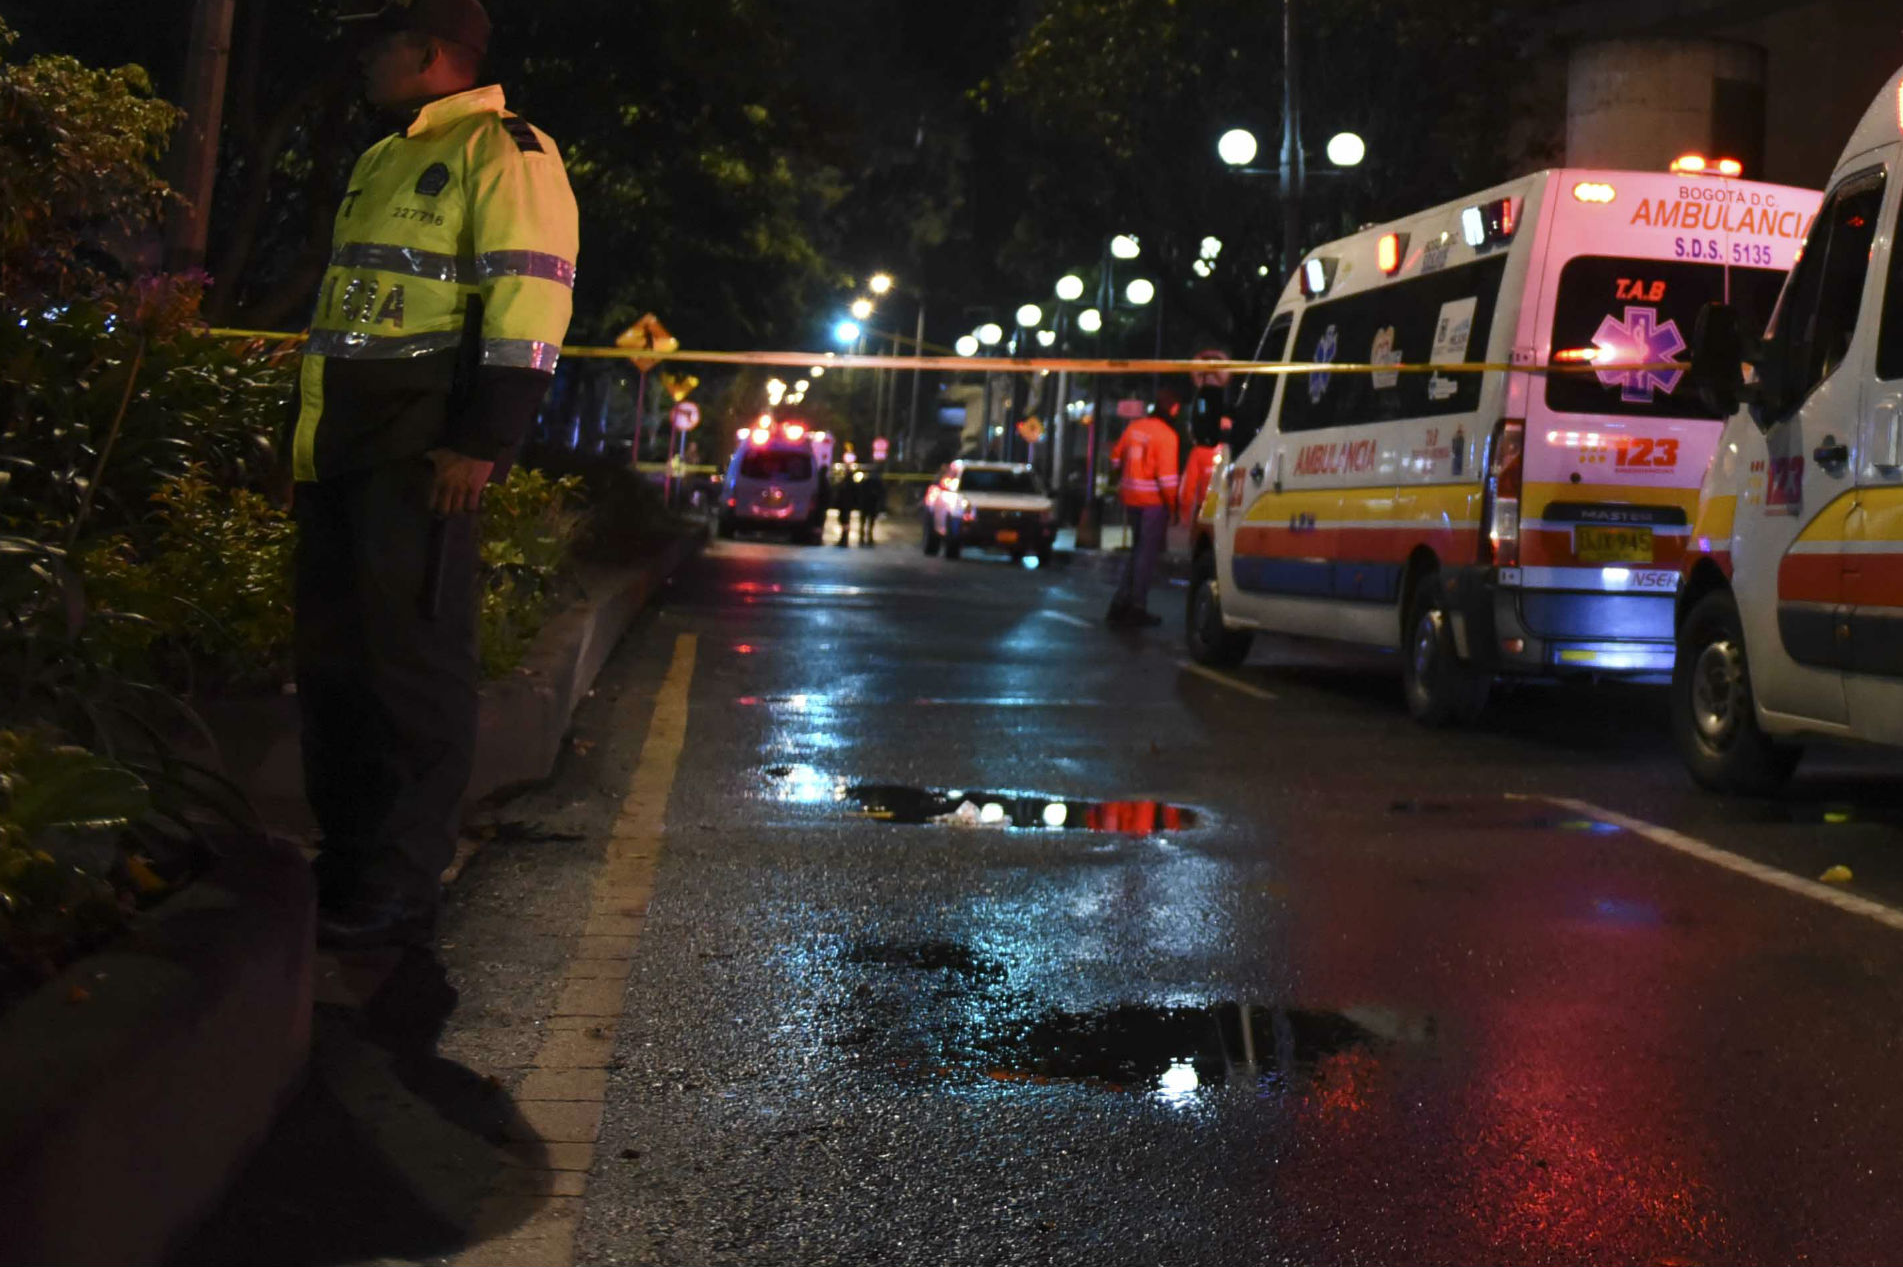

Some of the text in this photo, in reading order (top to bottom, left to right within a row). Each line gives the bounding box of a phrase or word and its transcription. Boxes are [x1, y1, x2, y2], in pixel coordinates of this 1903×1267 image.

[1679, 185, 1780, 208] BOGOTÁ D.C.
[1675, 236, 1771, 265] S.D.S. 5135
[1615, 437, 1680, 467] 123
